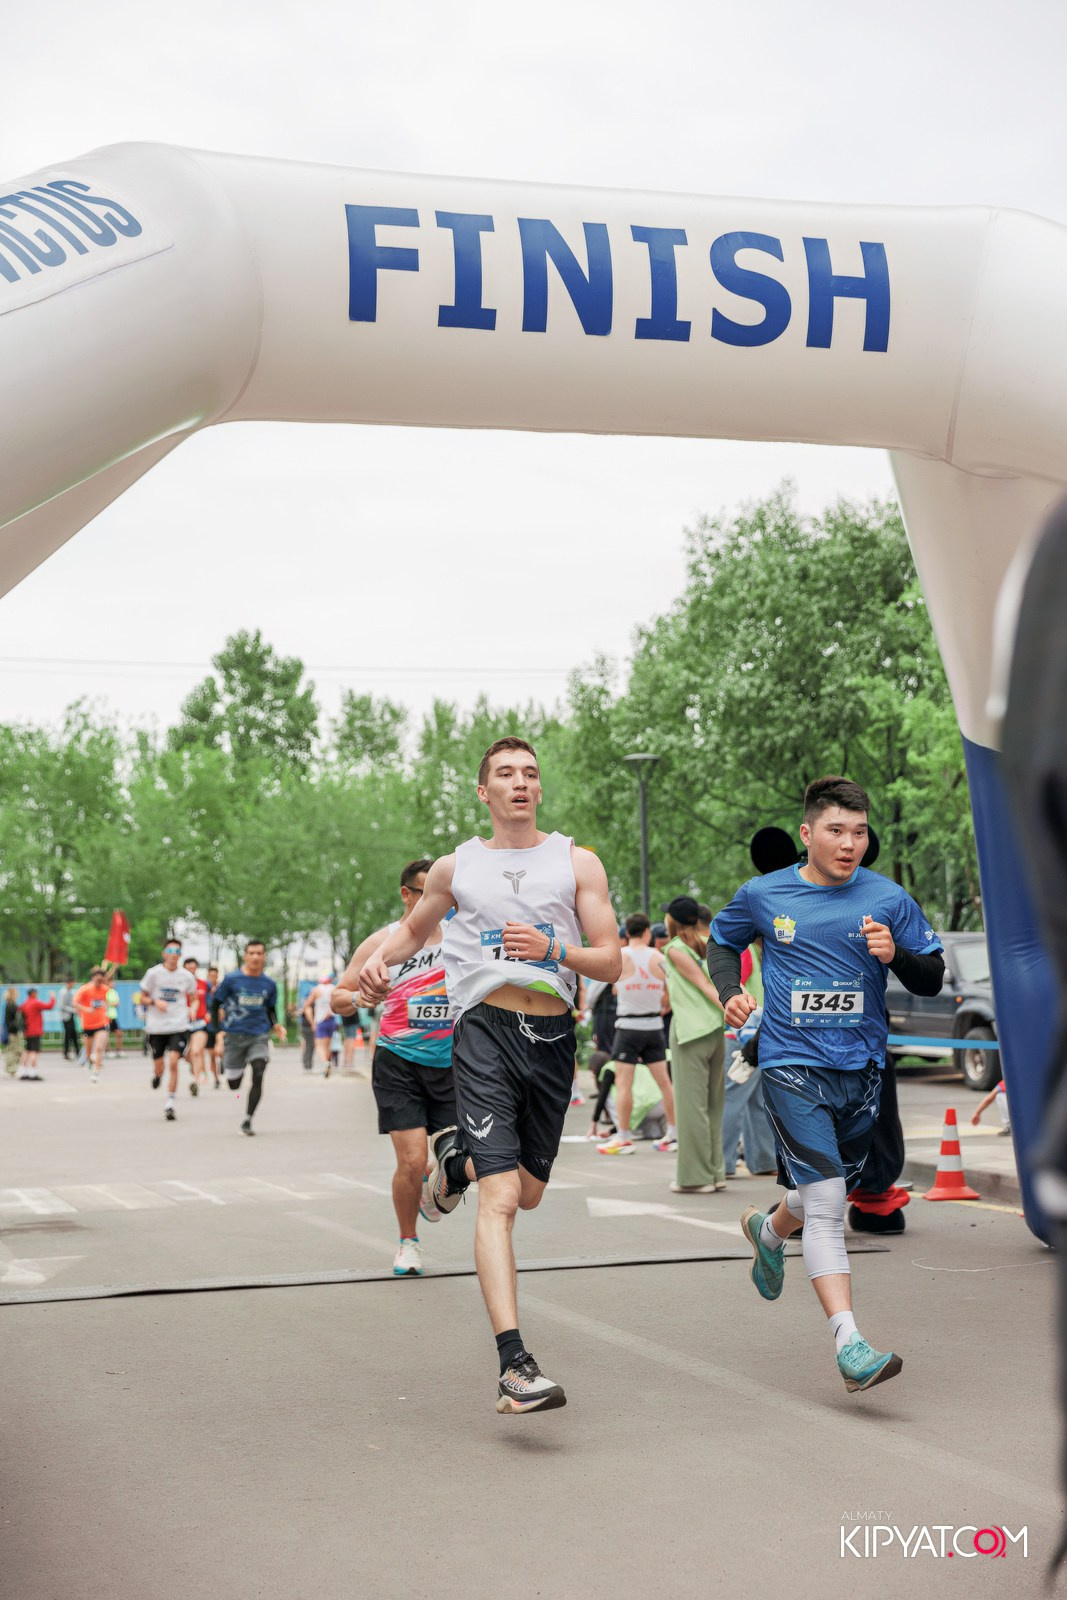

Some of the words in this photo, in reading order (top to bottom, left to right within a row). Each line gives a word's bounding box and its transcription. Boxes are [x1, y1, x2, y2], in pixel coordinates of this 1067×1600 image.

[345, 204, 891, 352] FINISH
[416, 1006, 449, 1018] 1631
[801, 993, 856, 1012] 1345
